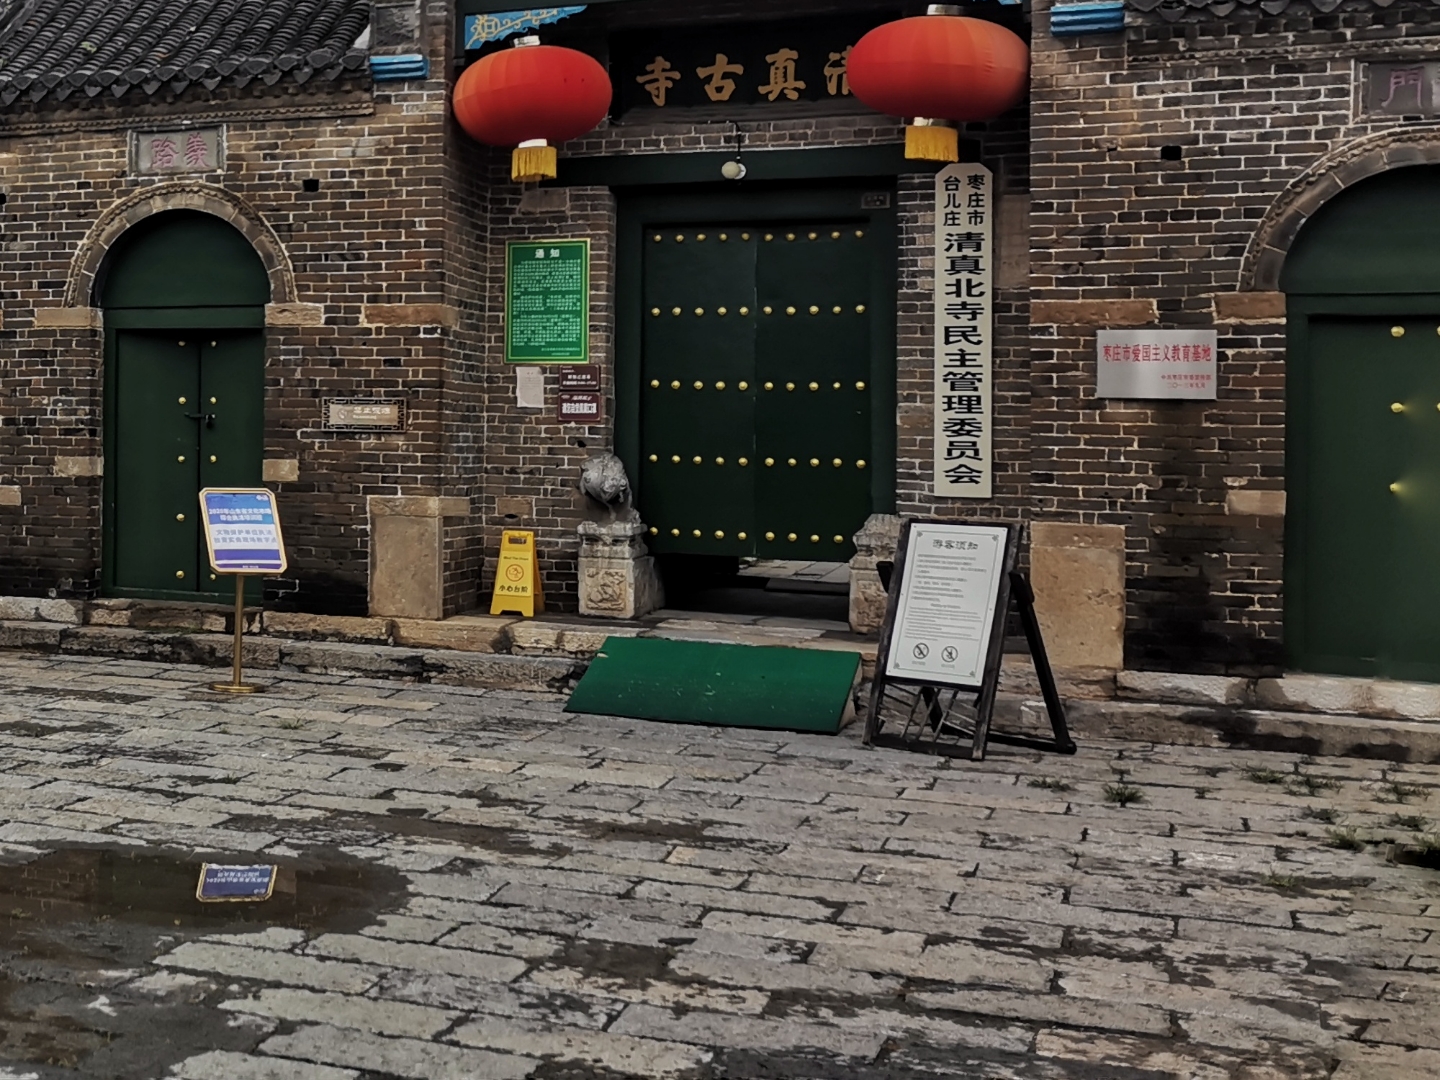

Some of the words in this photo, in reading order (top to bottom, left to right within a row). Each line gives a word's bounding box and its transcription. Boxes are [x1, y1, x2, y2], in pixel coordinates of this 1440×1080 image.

[943, 175, 962, 227] 台儿庄
[966, 173, 986, 227] 枣庄市
[534, 248, 560, 259] 通知
[942, 231, 986, 485] 清真北寺民主管理委员会
[1102, 343, 1212, 363] 枣庄市爱国主义教育基地
